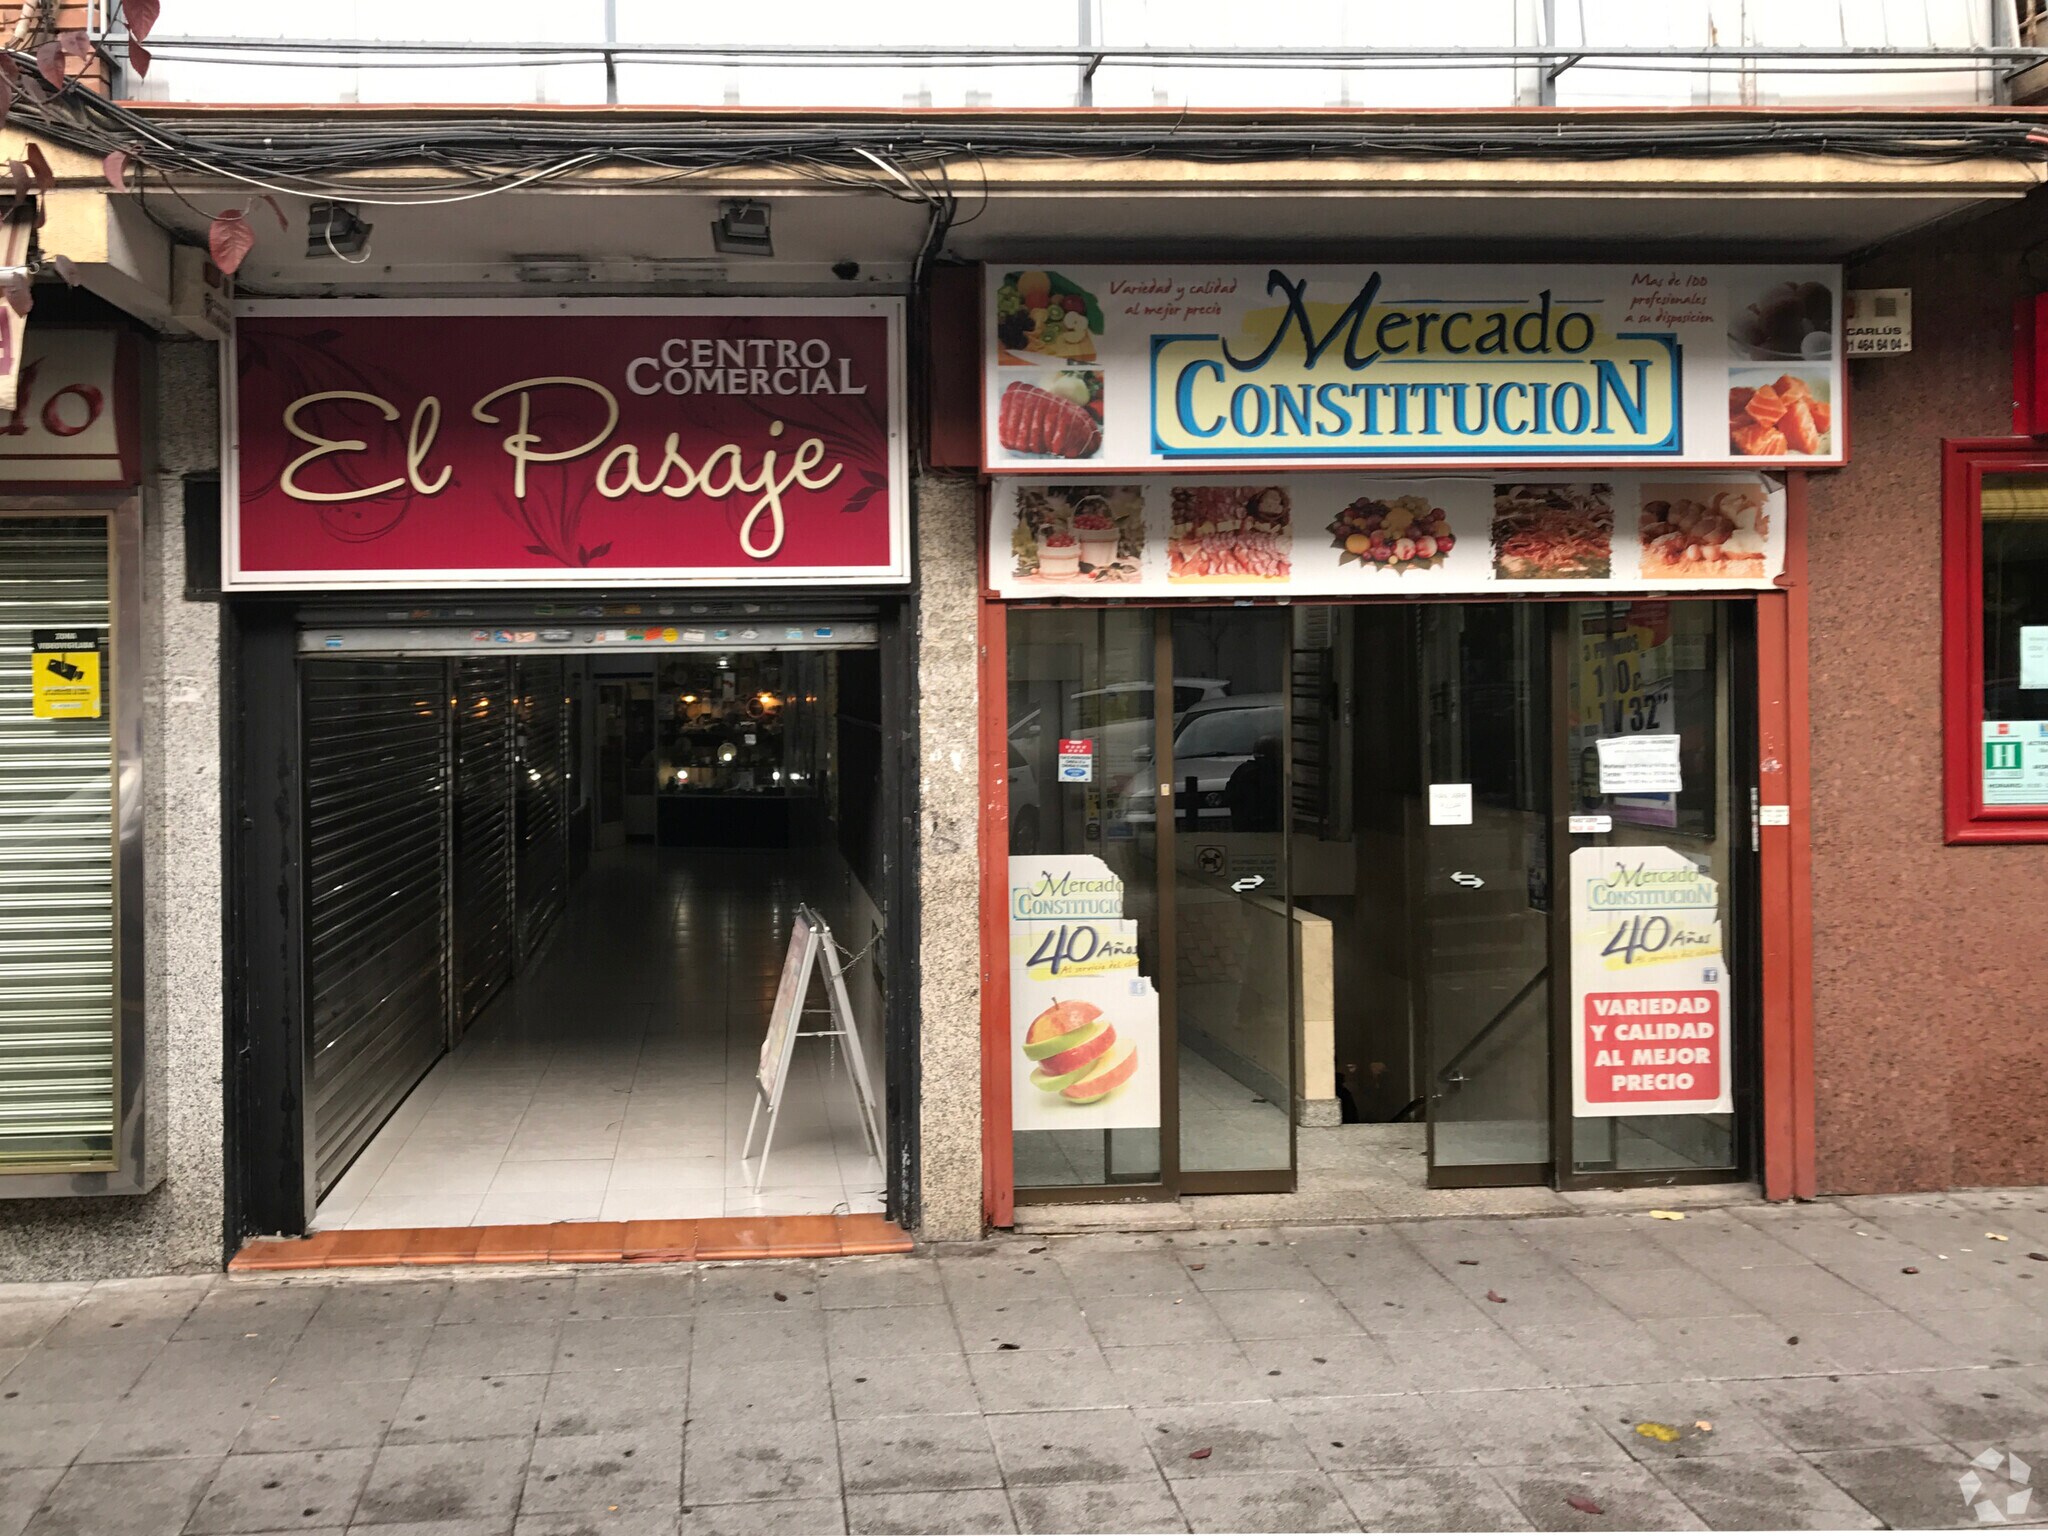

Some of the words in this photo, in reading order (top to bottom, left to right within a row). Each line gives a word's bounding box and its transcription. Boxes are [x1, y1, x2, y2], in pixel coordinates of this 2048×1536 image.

[1110, 278, 1173, 295] Variedad
[1174, 286, 1185, 301] y
[1189, 278, 1238, 294] calidad
[1667, 271, 1681, 286] de
[1124, 303, 1140, 315] al
[1144, 303, 1182, 321] mejor
[1182, 302, 1222, 321] precio
[1629, 290, 1707, 310] profesionales
[1221, 268, 1596, 371] Mercado
[661, 338, 831, 368] CENTRO
[625, 356, 868, 395] COMERCIAL
[1174, 357, 1653, 438] CONSTITUCION
[279, 390, 453, 502] El
[471, 376, 843, 559] Pasaje
[1030, 870, 1124, 897] Mercado
[1606, 862, 1698, 888] Mercado
[1026, 924, 1099, 975] 40
[1600, 915, 1671, 964] 40
[1593, 997, 1711, 1017] VARIEDAD
[1589, 1024, 1608, 1042] Y
[1614, 1022, 1715, 1041] CALIDAD
[1594, 1050, 1625, 1067] AL
[1631, 1047, 1712, 1066] MEJOR
[1611, 1073, 1695, 1092] PRECIO
